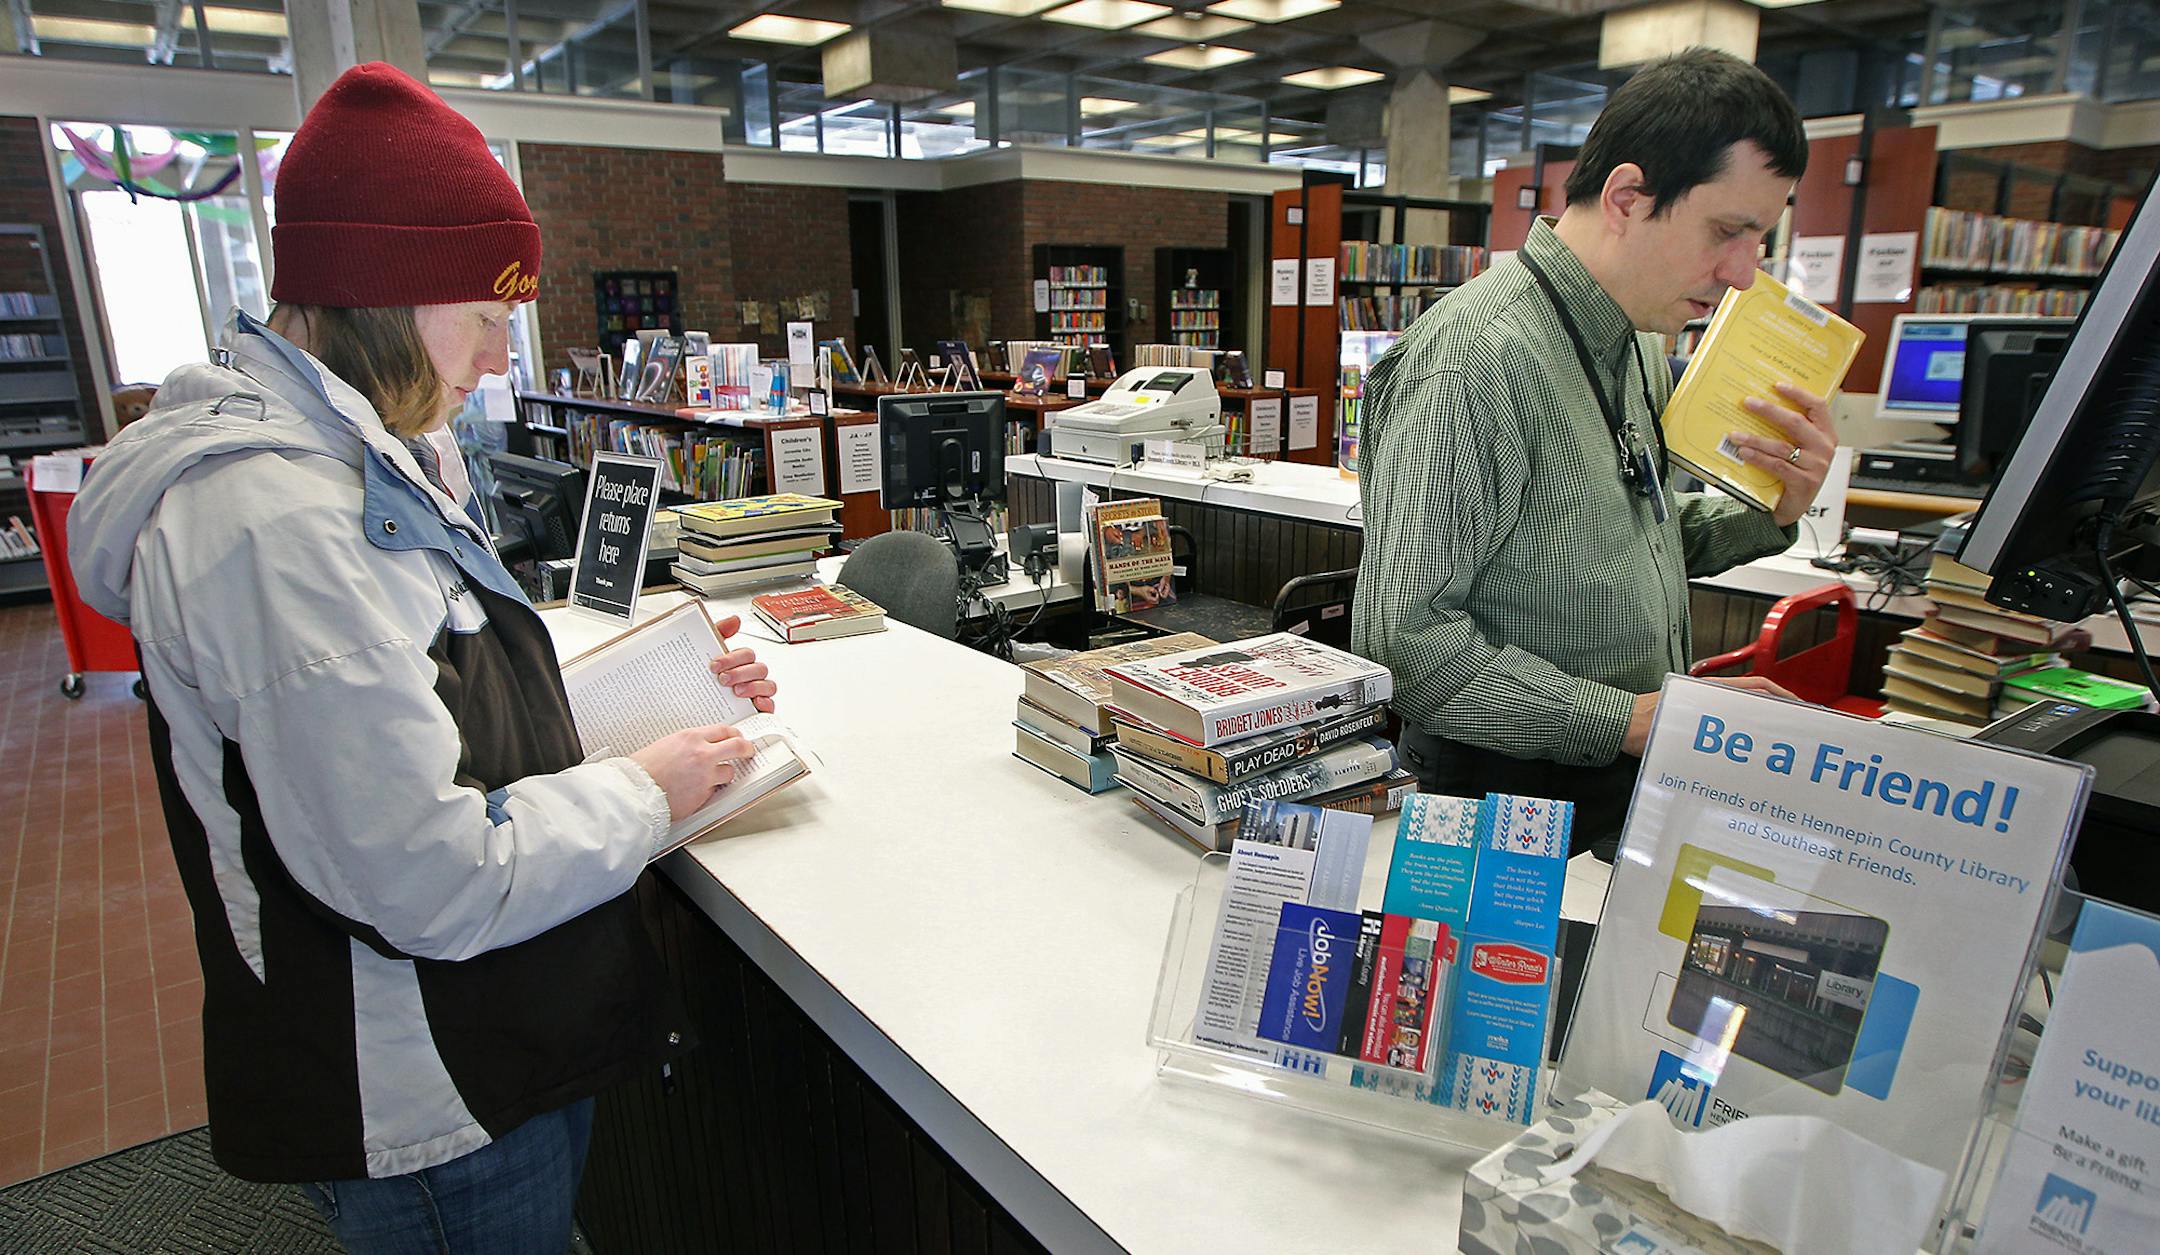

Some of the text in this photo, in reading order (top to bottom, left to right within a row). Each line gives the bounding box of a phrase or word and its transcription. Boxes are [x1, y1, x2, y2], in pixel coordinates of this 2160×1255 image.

[780, 436, 812, 444] Children's
[595, 474, 649, 509] Please place
[598, 511, 632, 535] returns
[1805, 505, 1830, 517] er
[598, 537, 620, 566] here
[1109, 562, 1131, 570] HANDS
[1155, 555, 1171, 563] MAYA
[1158, 666, 1252, 697] BRIDGET
[1209, 663, 1287, 690] JONES
[1216, 713, 1252, 738] BRIDGET
[1254, 706, 1283, 729] JONES
[1319, 714, 1374, 743] DAVID ROSENFELT
[1234, 743, 1295, 777] PLAY DEAD
[1692, 714, 2020, 834] Be a Friend!
[1217, 772, 1311, 812] GHOST SOLDIERS
[1658, 772, 2031, 894] Join Friends of the Hennepin County Library
[1237, 848, 1253, 857] About
[1409, 852, 1426, 861] Books
[1728, 818, 1917, 886] and Southeast Friends.
[1401, 867, 1412, 876] They
[1517, 867, 1532, 875] book
[1410, 886, 1422, 895] They
[1505, 884, 1524, 892] thinks
[1526, 896, 1545, 904] which
[1513, 903, 1525, 911] you
[1355, 934, 1367, 959] Library
[1301, 924, 1335, 1020] JobNow!
[1358, 961, 1373, 987] County
[1487, 956, 1516, 968] Winter
[1282, 947, 1308, 1041] Live Job Assistance
[1826, 979, 1864, 998] Library
[2083, 1048, 2160, 1094] Suppo
[1713, 1098, 1749, 1120] FRIE
[2075, 1078, 2160, 1126] your lib
[2058, 1125, 2150, 1175] Make a gift.
[2052, 1143, 2144, 1196] Be a Friend.
